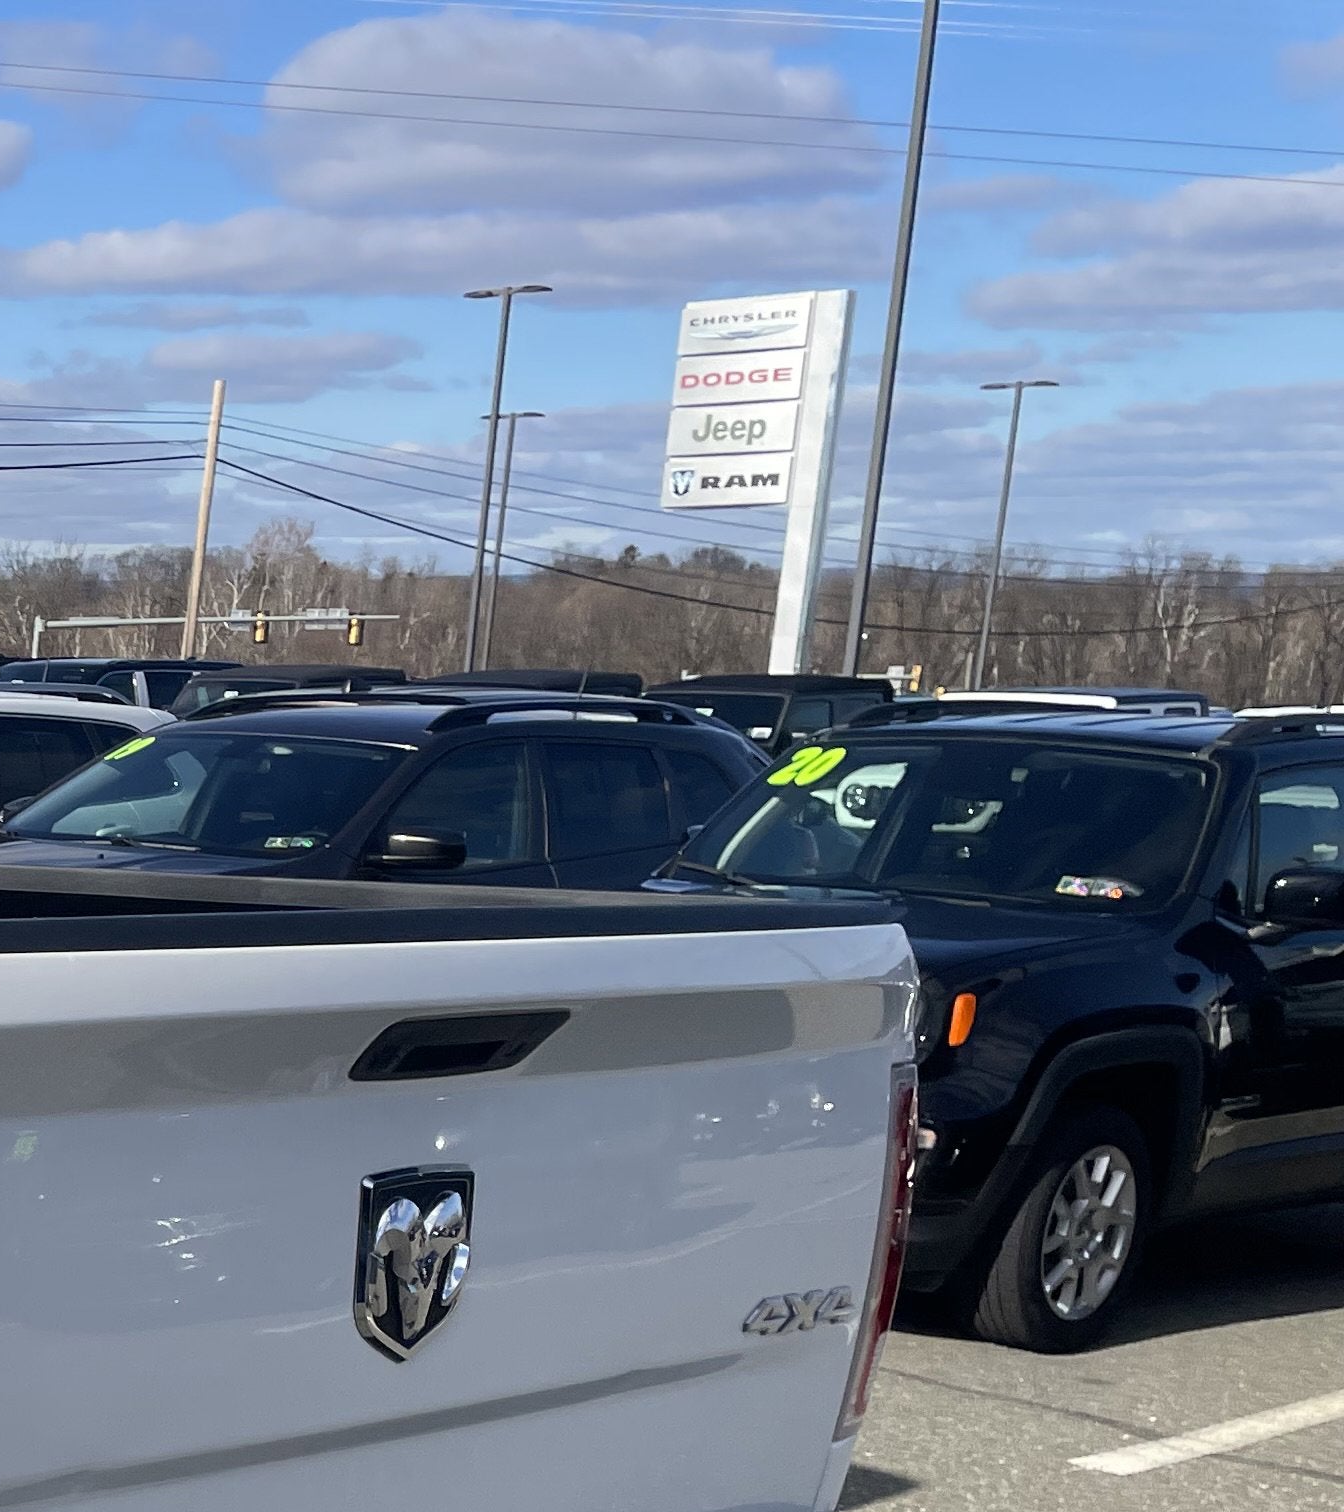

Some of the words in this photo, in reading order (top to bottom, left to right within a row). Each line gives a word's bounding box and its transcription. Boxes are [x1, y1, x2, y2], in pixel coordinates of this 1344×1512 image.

[689, 309, 798, 327] CHRYSLER
[680, 367, 794, 390] DODGE
[691, 414, 768, 446] Jeep
[700, 472, 781, 490] RAM
[766, 746, 847, 787] 20
